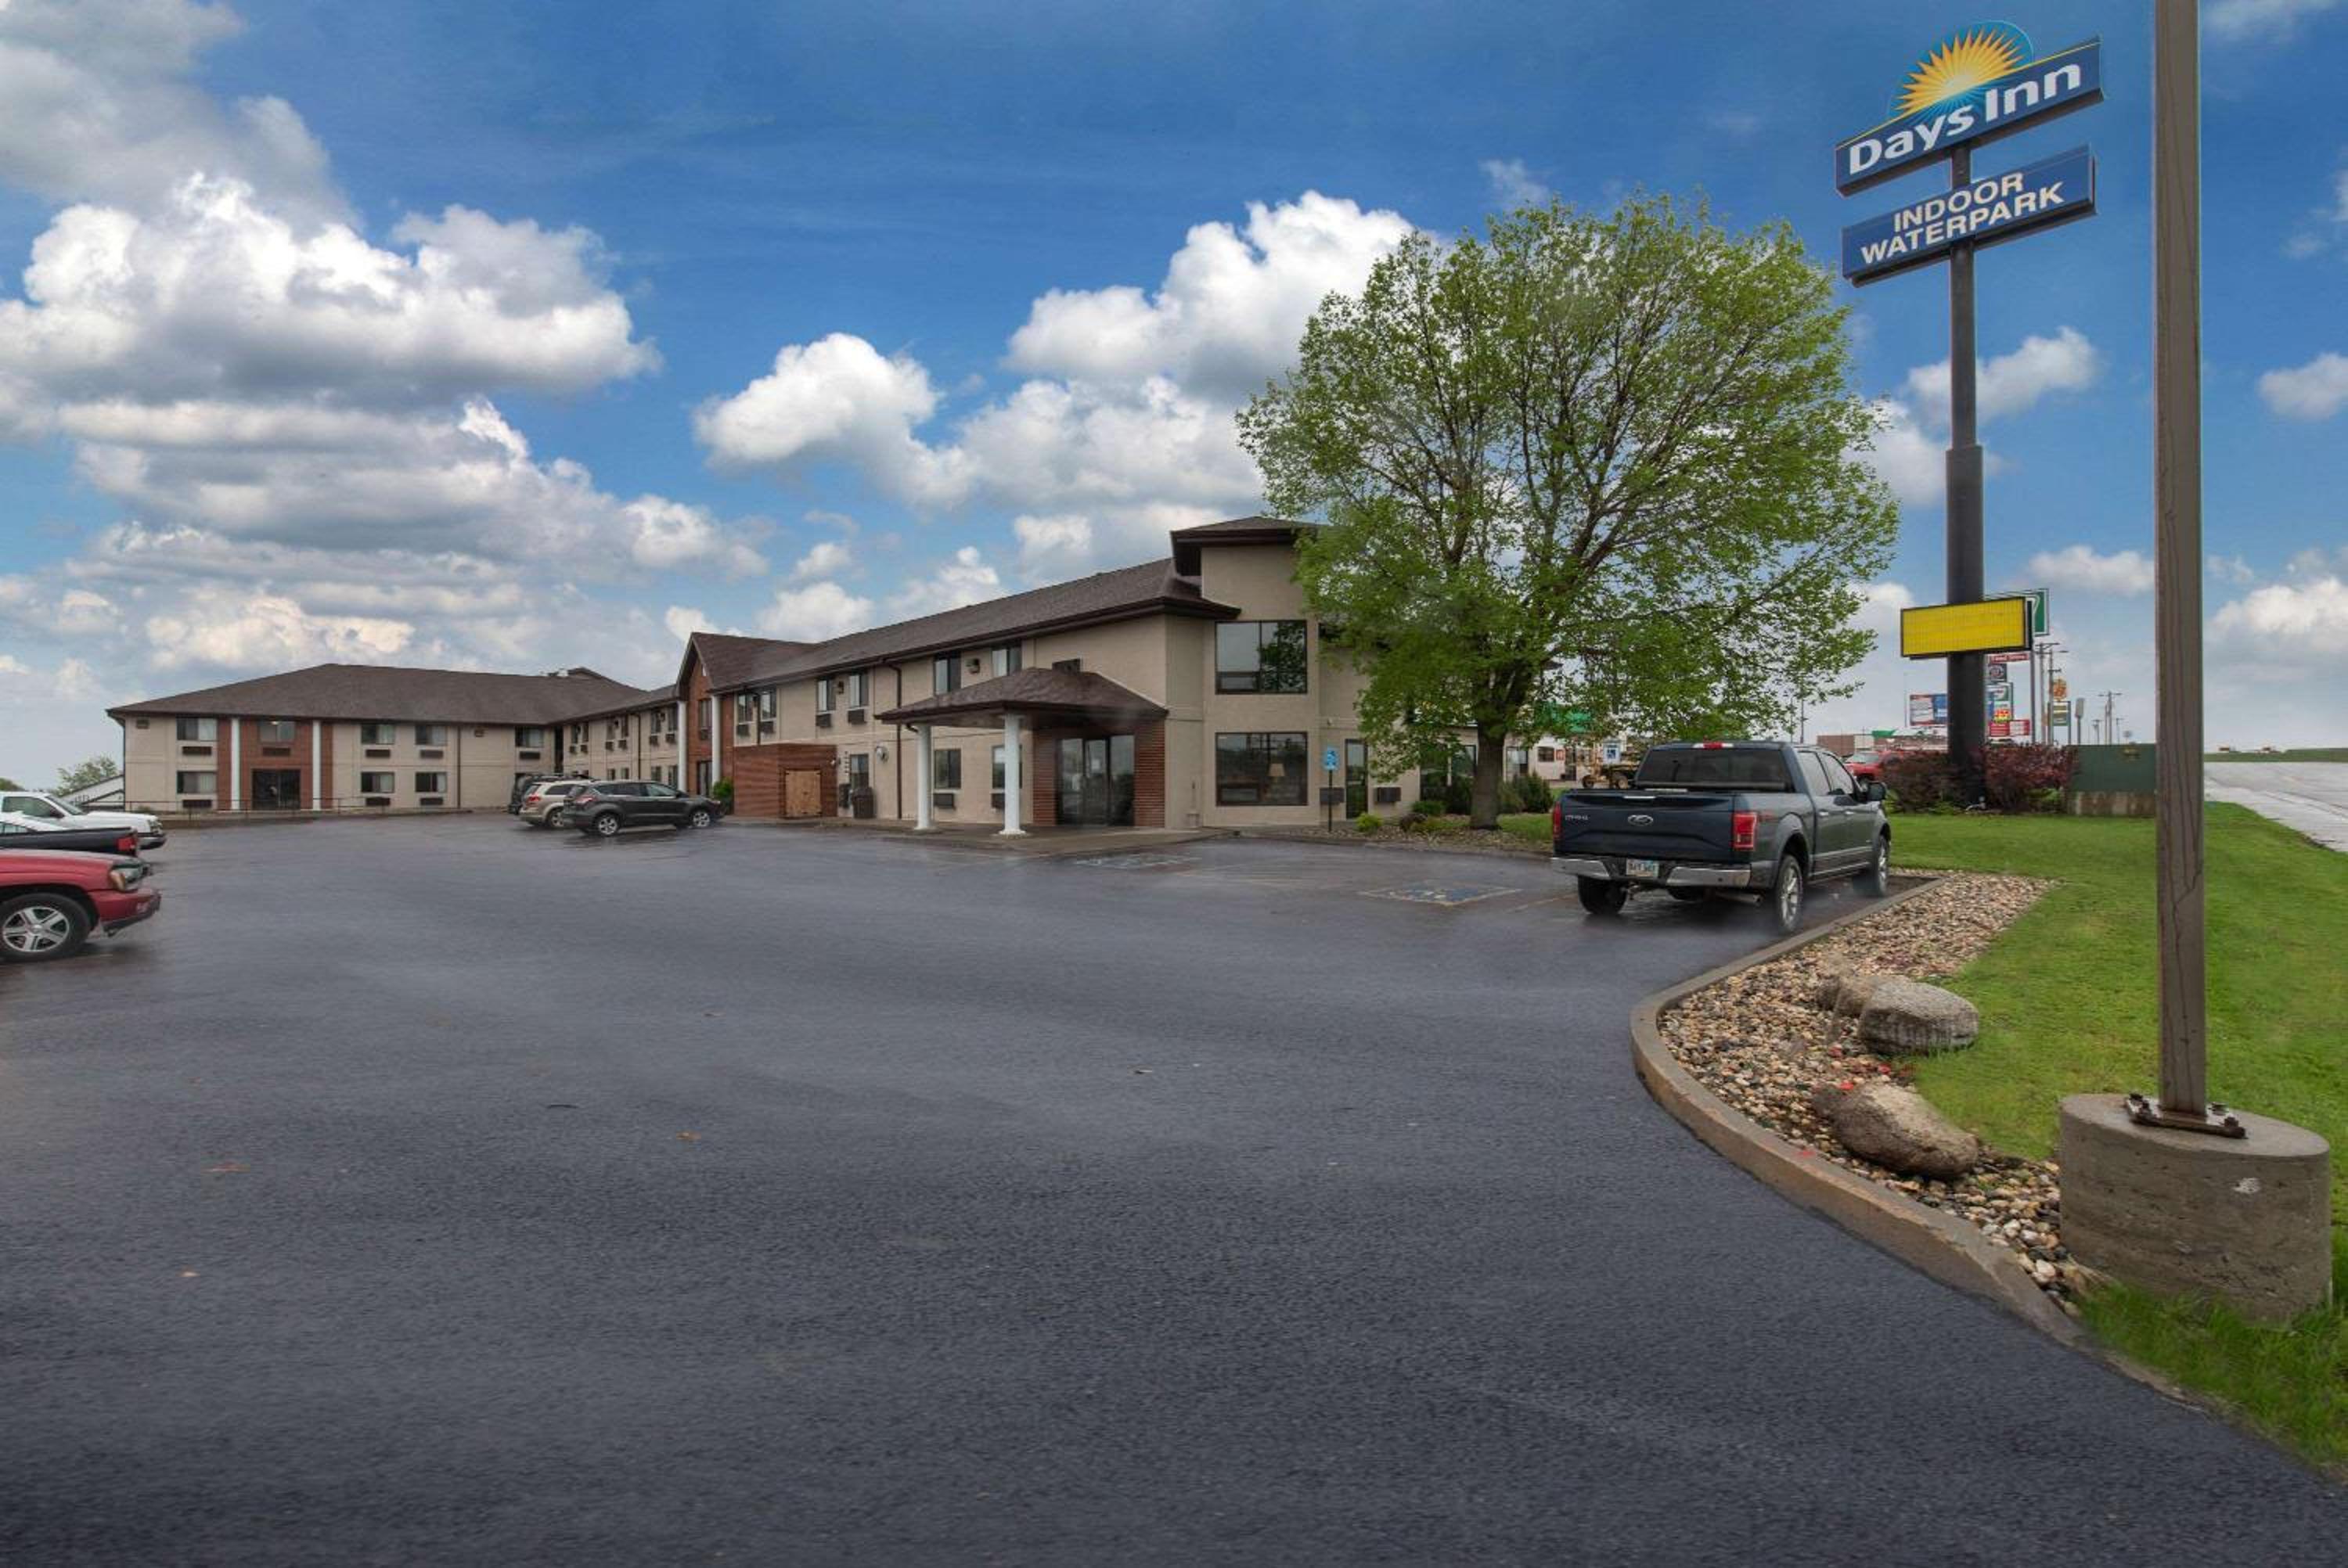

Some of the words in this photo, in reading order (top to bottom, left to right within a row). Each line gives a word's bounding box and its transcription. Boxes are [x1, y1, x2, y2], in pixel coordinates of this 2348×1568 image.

[1849, 105, 1975, 175] Days
[1985, 63, 2081, 122] Inn
[1860, 182, 2064, 264] WATERPARK
[1893, 171, 2024, 233] INDOOR
